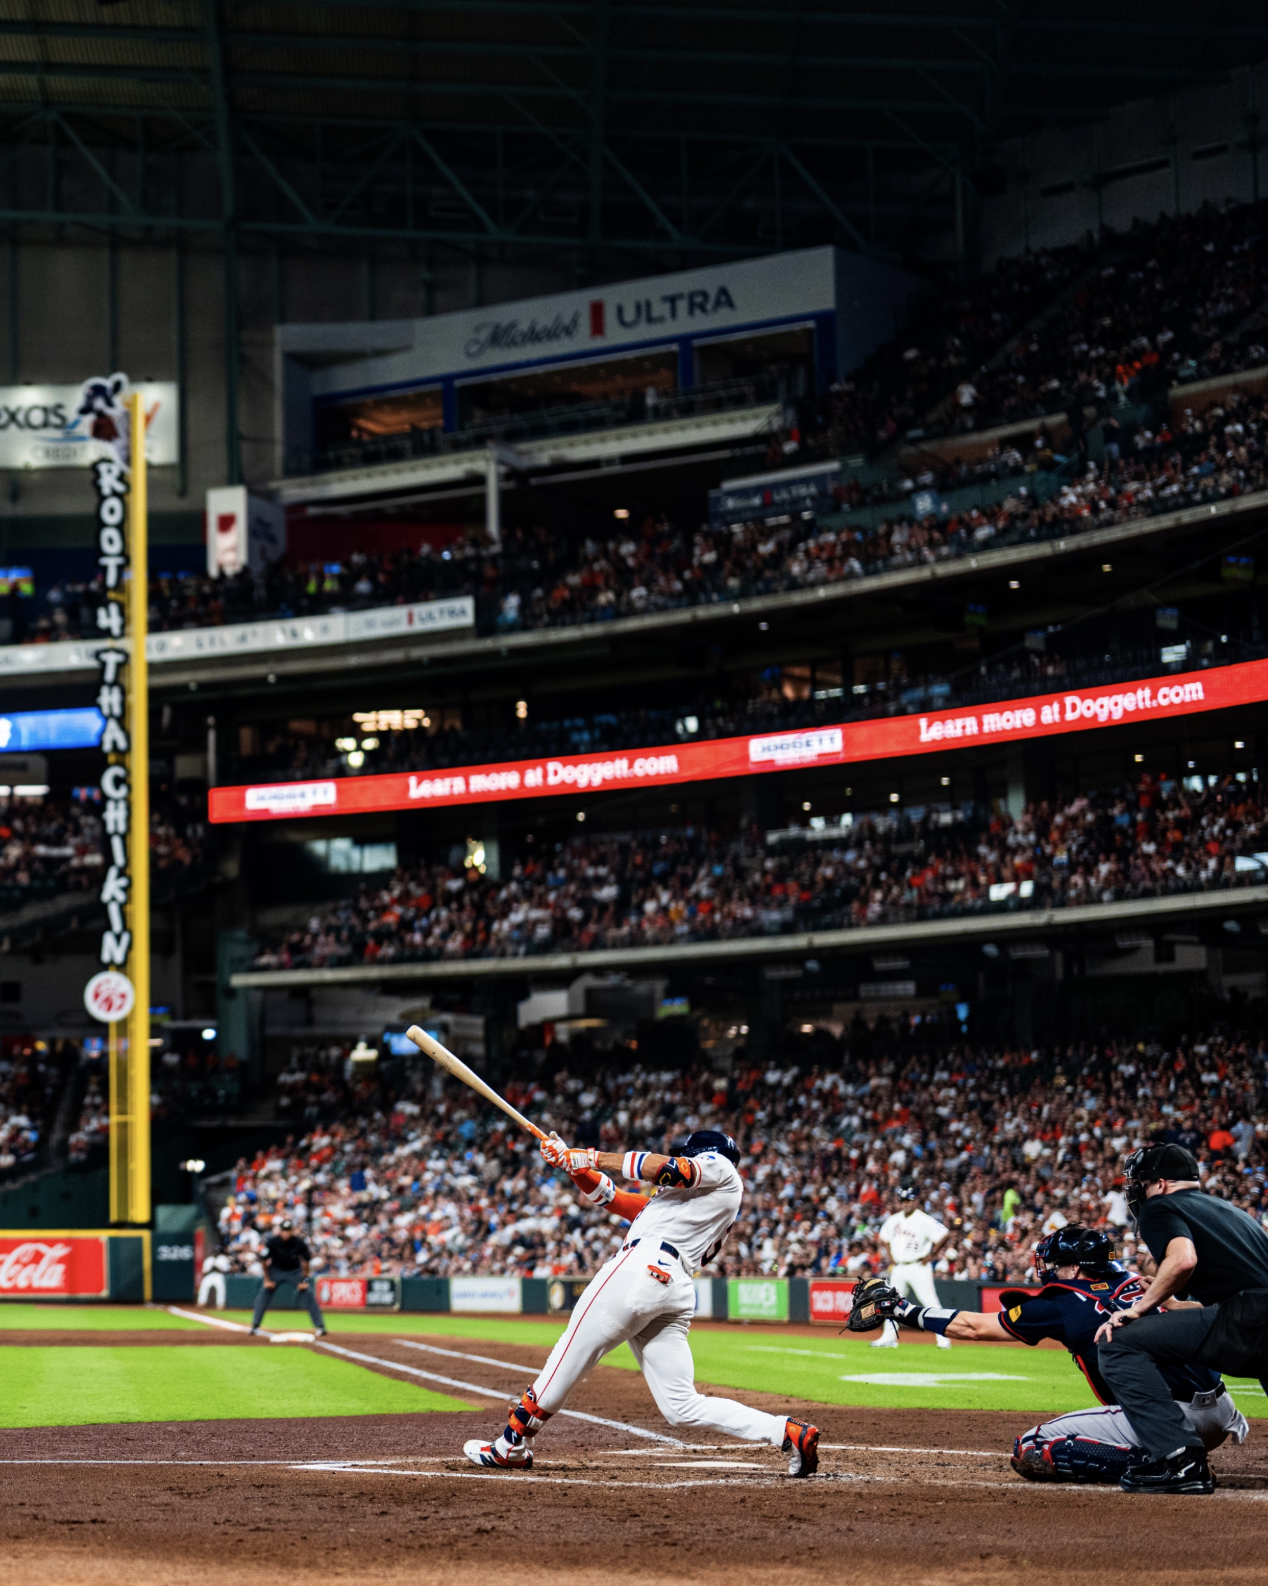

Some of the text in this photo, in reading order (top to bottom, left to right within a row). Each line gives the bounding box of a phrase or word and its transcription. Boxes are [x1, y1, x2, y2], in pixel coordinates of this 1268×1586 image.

[616, 285, 736, 329] ULTRA
[96, 462, 127, 588] ROOT
[919, 680, 1204, 743] Learn more at Doggett.com
[408, 753, 679, 800] Learn more at Doggett.com
[100, 766, 130, 966] CHIKIN
